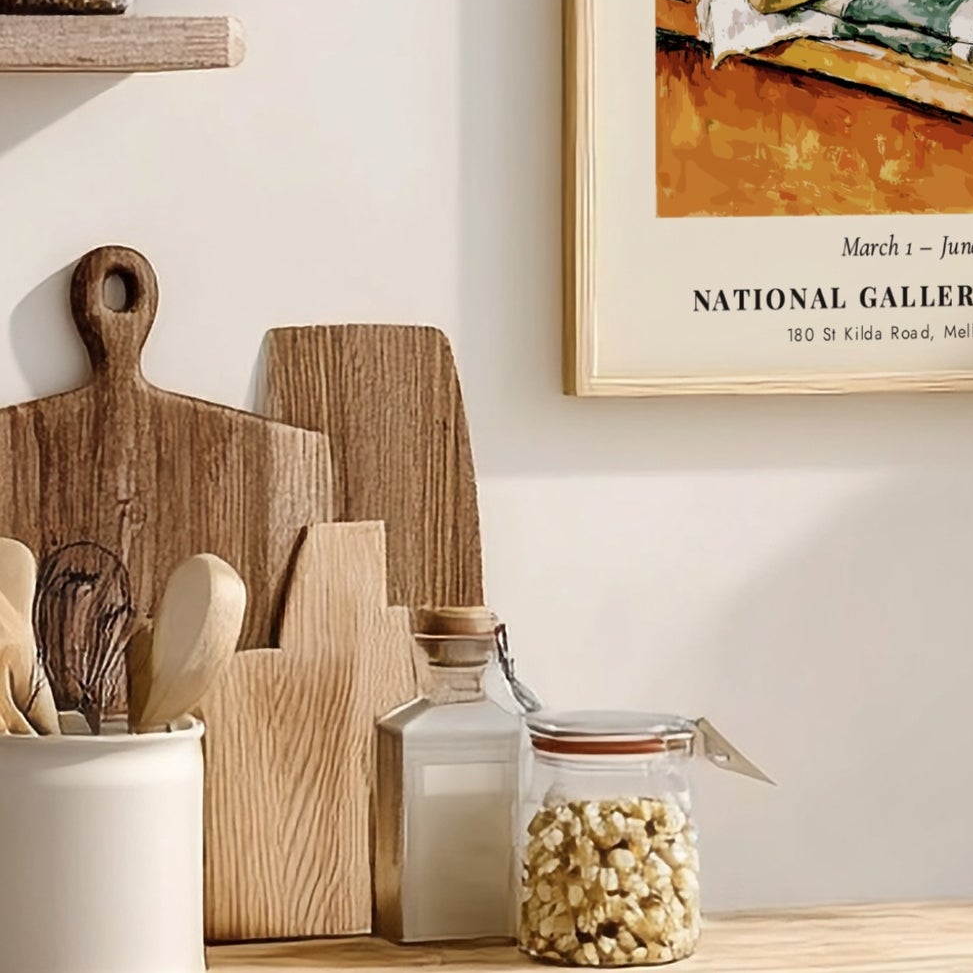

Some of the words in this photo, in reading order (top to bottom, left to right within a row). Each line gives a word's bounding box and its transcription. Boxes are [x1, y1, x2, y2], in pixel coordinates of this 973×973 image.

[841, 234, 899, 257] March
[904, 242, 913, 257] 1
[693, 287, 846, 312] NATIONAL
[787, 327, 814, 342] 180
[823, 327, 836, 341] St
[844, 325, 882, 341] Kilda
[891, 324, 934, 342] Road,
